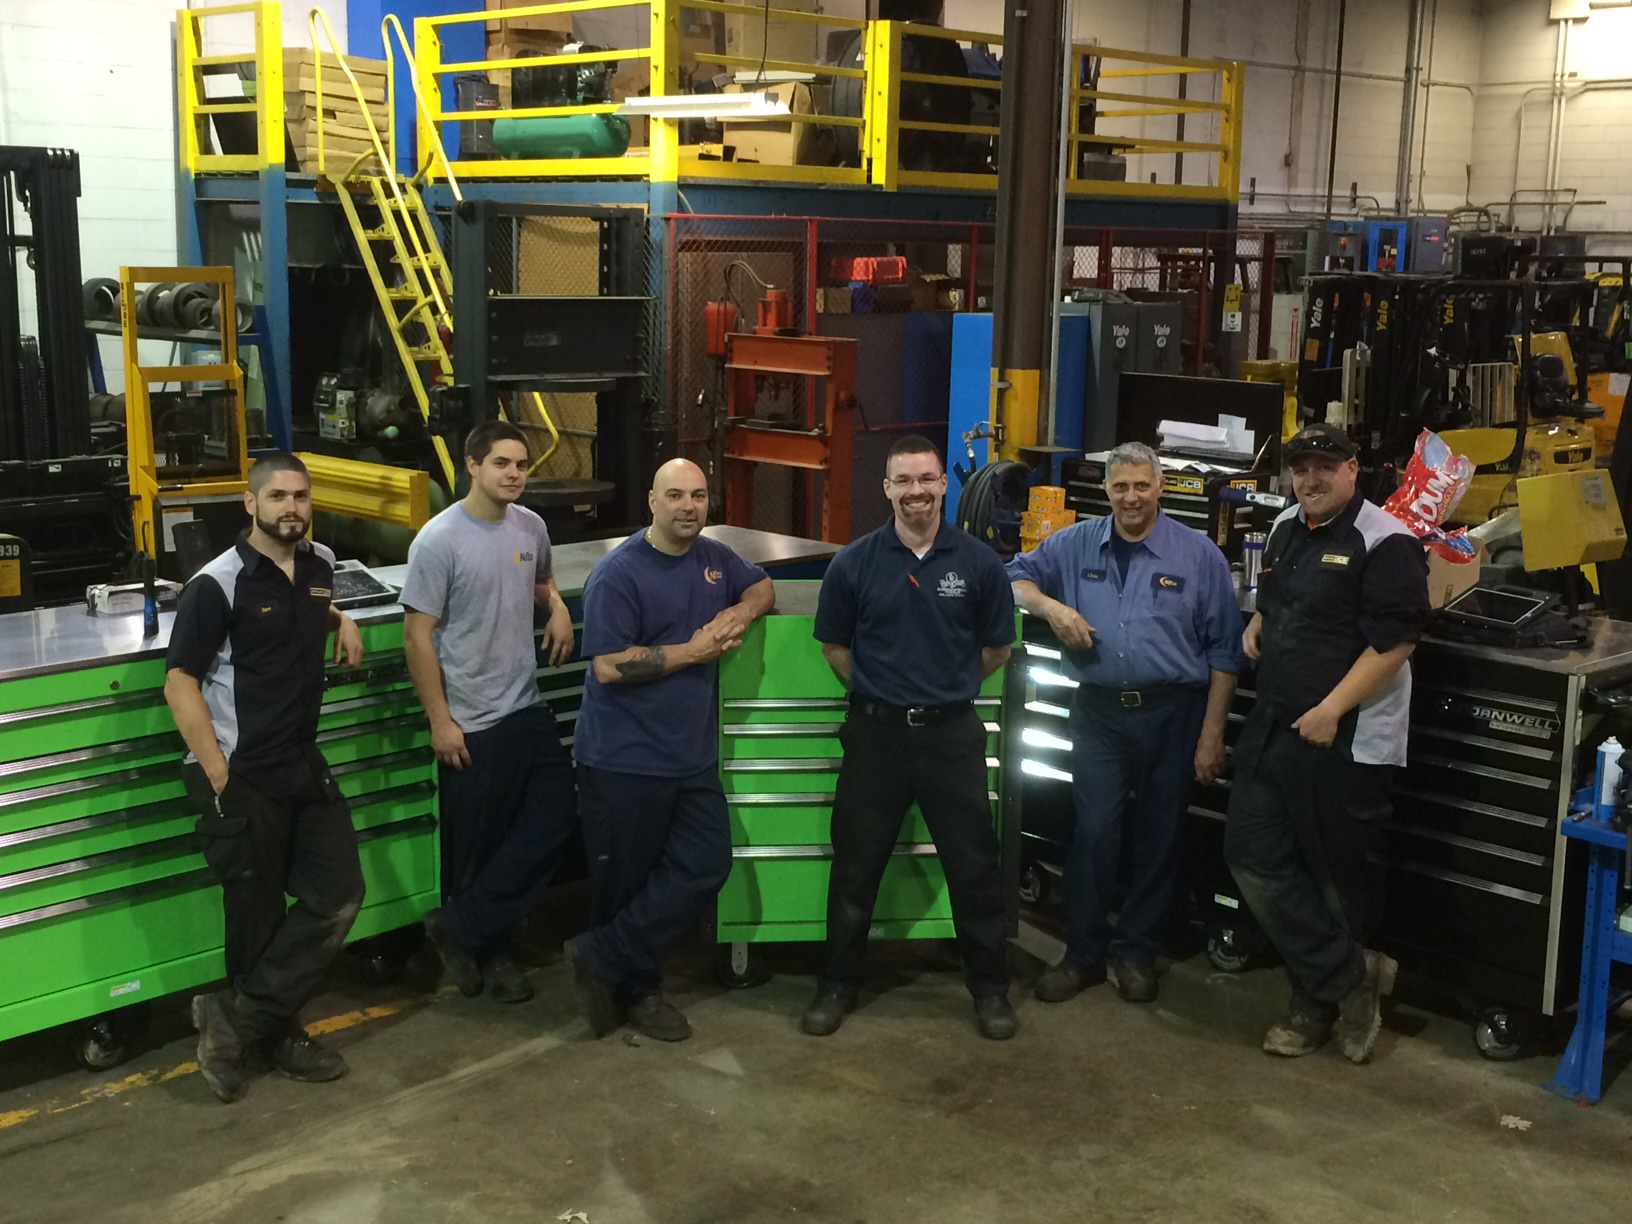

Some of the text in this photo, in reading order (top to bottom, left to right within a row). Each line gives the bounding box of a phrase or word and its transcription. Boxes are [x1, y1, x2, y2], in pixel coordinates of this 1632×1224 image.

[1310, 297, 1324, 329] Yale
[1376, 299, 1389, 331] Yale
[1443, 298, 1455, 325] Yale
[1112, 324, 1130, 336] Yale
[1154, 324, 1171, 336] Yale
[1179, 479, 1202, 489] JCB
